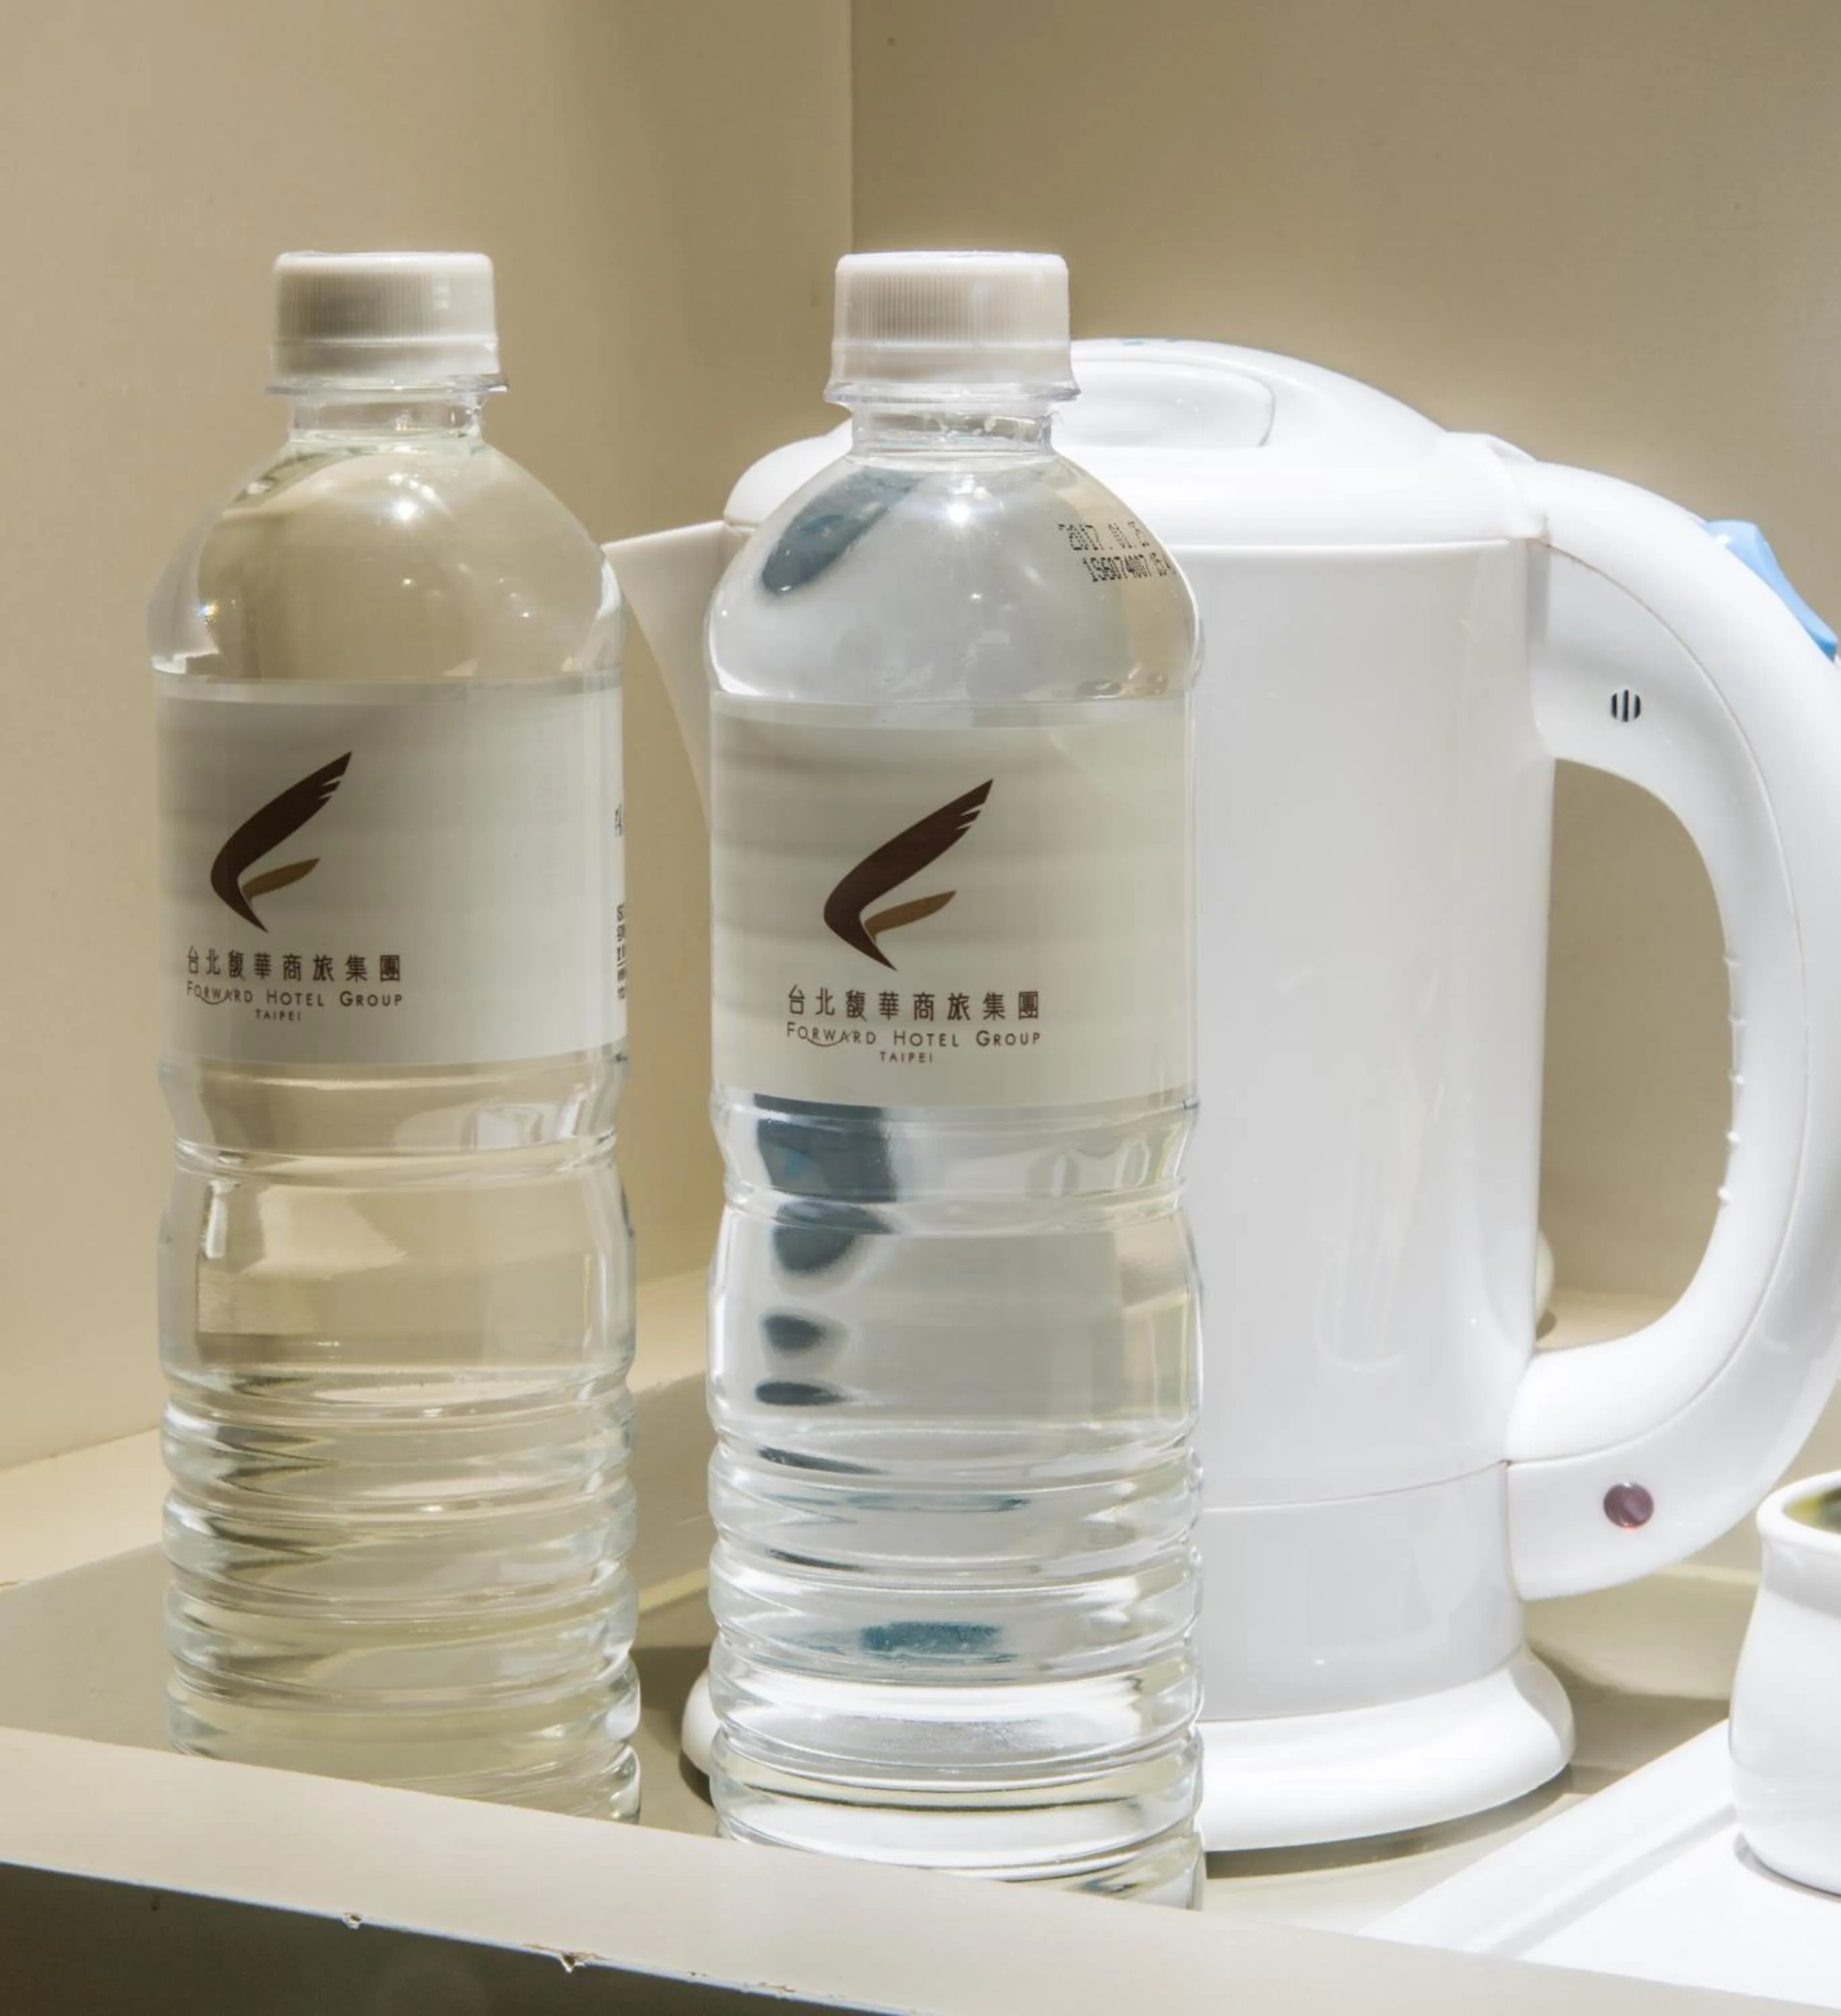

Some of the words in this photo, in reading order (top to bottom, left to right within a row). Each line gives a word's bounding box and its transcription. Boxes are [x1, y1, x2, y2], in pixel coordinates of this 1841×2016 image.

[187, 946, 401, 982] 台北馥華商旅集團
[187, 980, 253, 1005] FORWARD
[267, 989, 324, 1007] HOTEL
[339, 991, 402, 1007] GROUP
[788, 984, 1039, 1021] 台北馥華商旅集團
[255, 1009, 301, 1021] TAIPEI
[787, 1022, 876, 1047] FORWARD
[894, 1030, 959, 1047] HOTEL
[976, 1030, 1040, 1046] GROUP
[880, 1051, 933, 1063] TAIPEI
